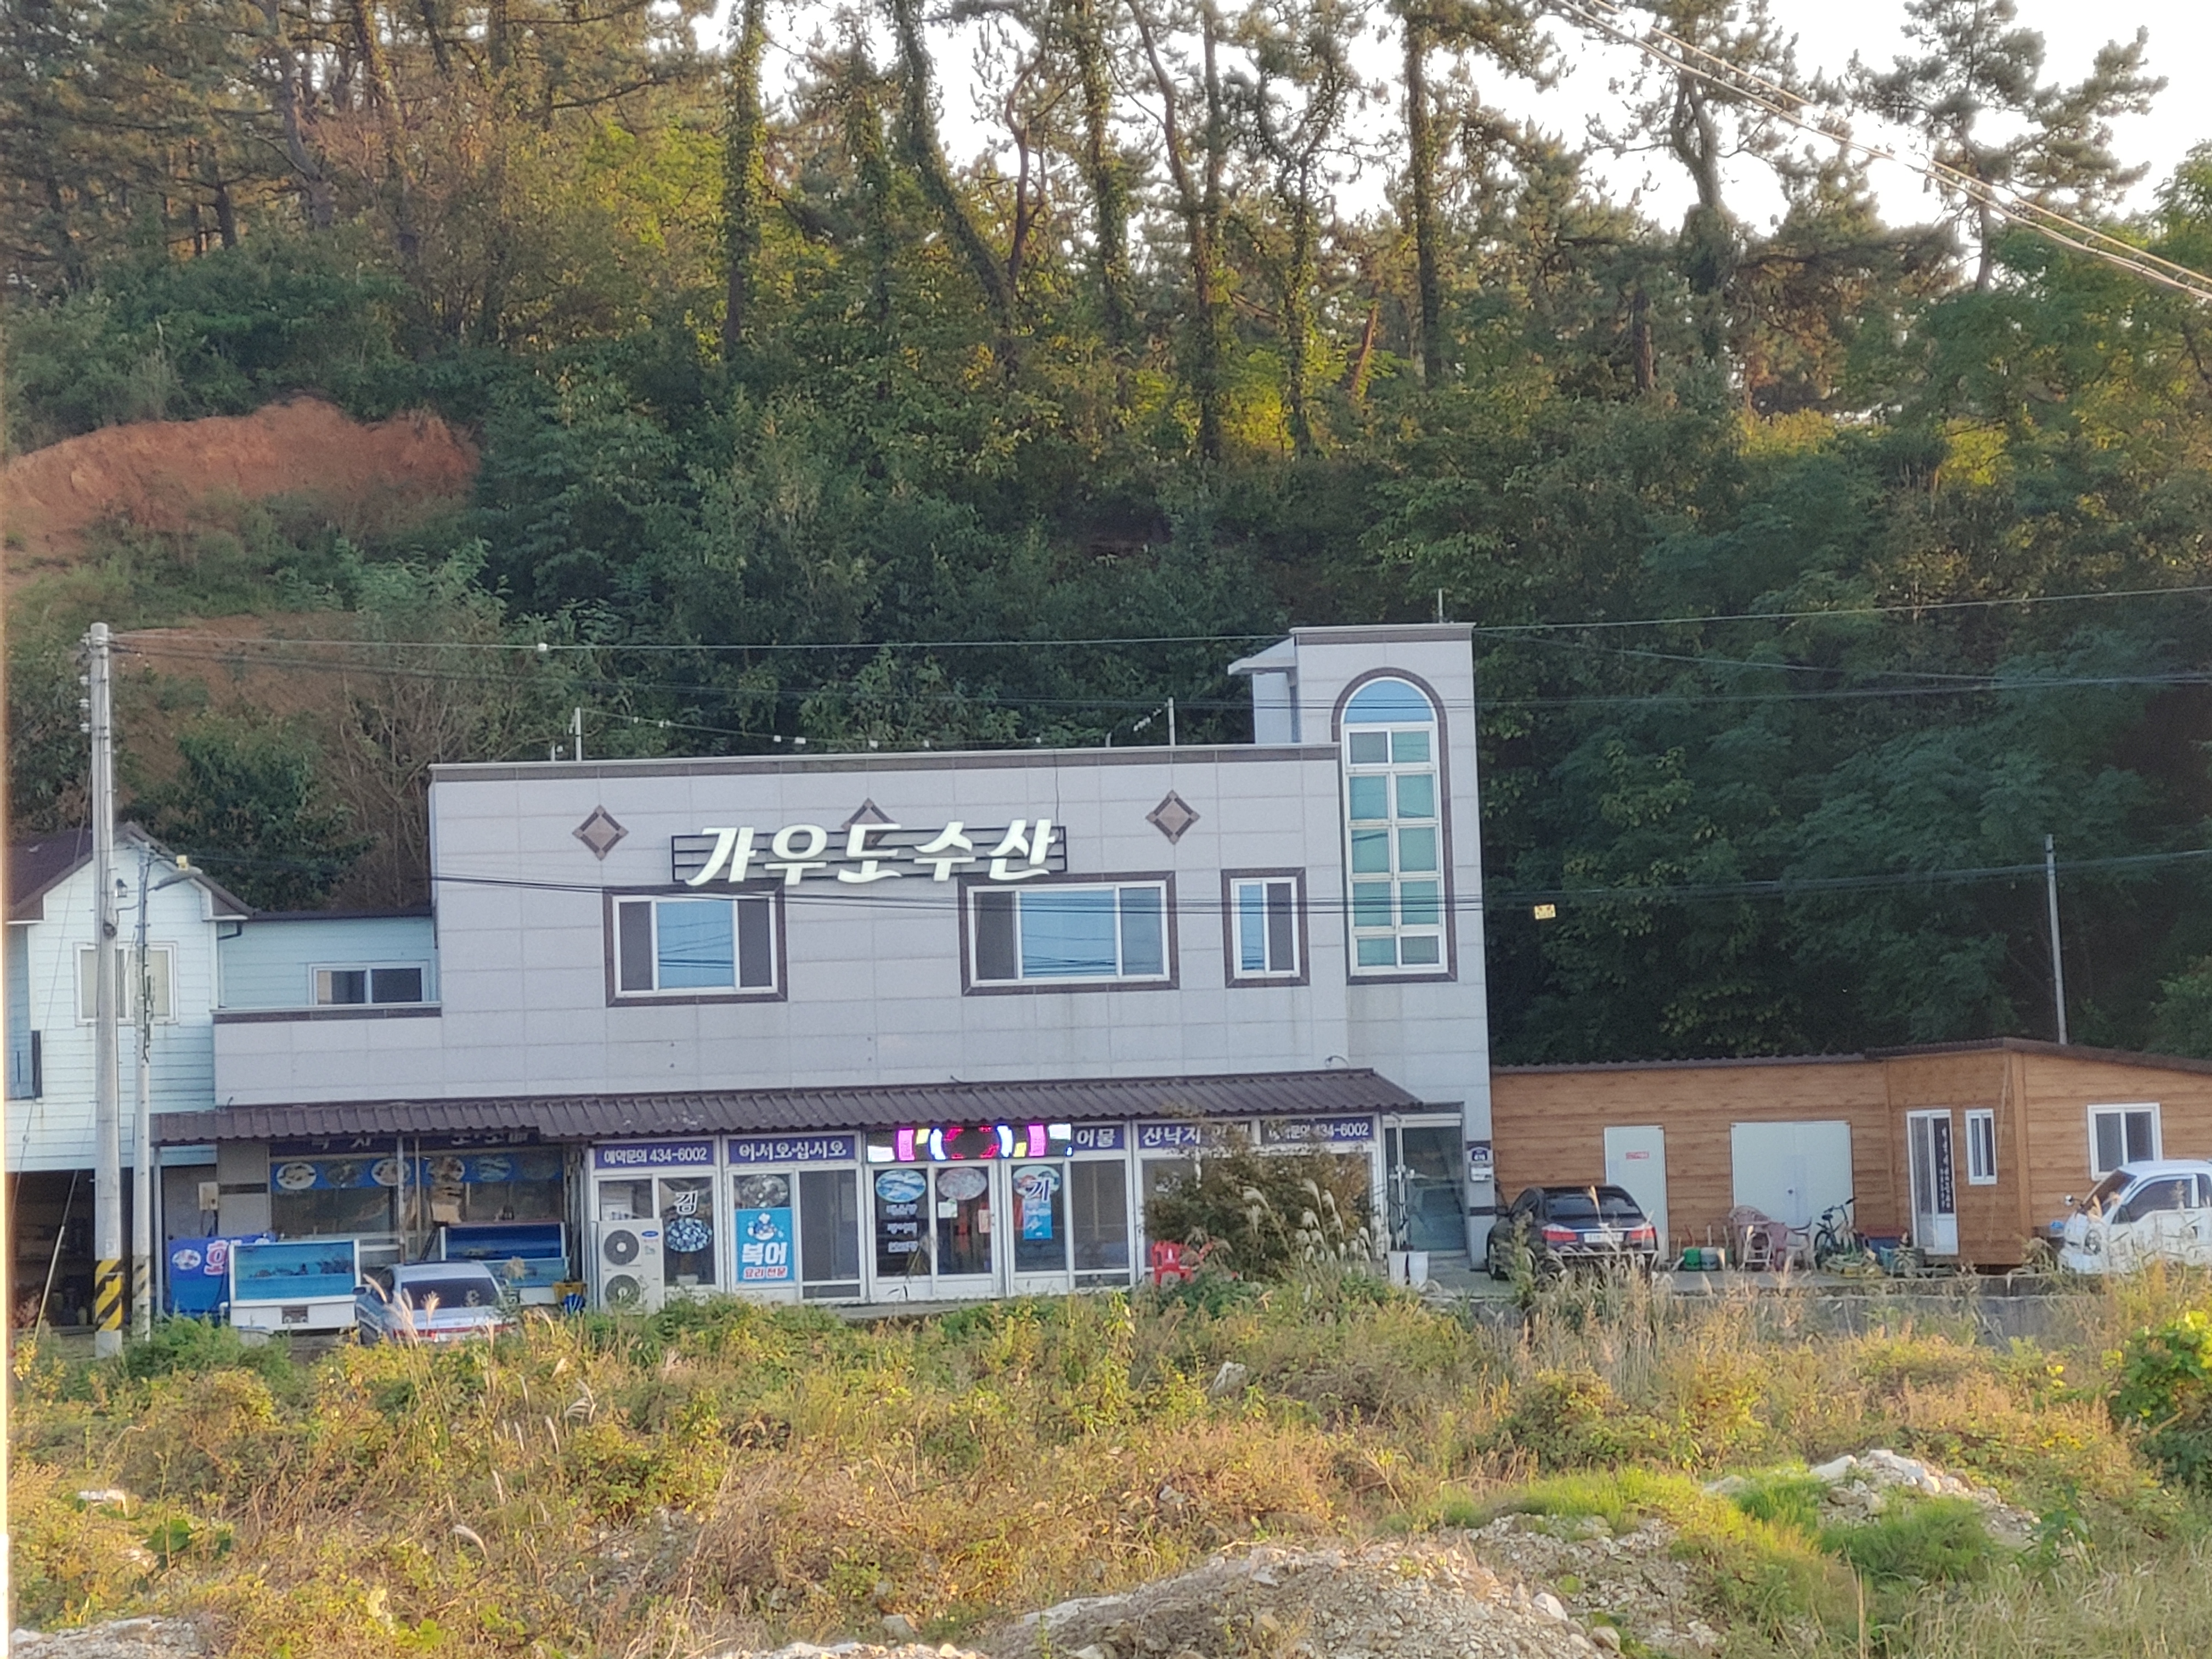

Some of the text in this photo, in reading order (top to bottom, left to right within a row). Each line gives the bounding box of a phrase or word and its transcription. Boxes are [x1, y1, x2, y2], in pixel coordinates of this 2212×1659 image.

[685, 819, 1056, 887] 가우도수산
[1143, 1126, 1201, 1146] 산낙지
[604, 1147, 707, 1164] 예약문의 434-6002
[739, 1141, 847, 1161] 어서오십시오
[742, 1242, 788, 1265] 복어
